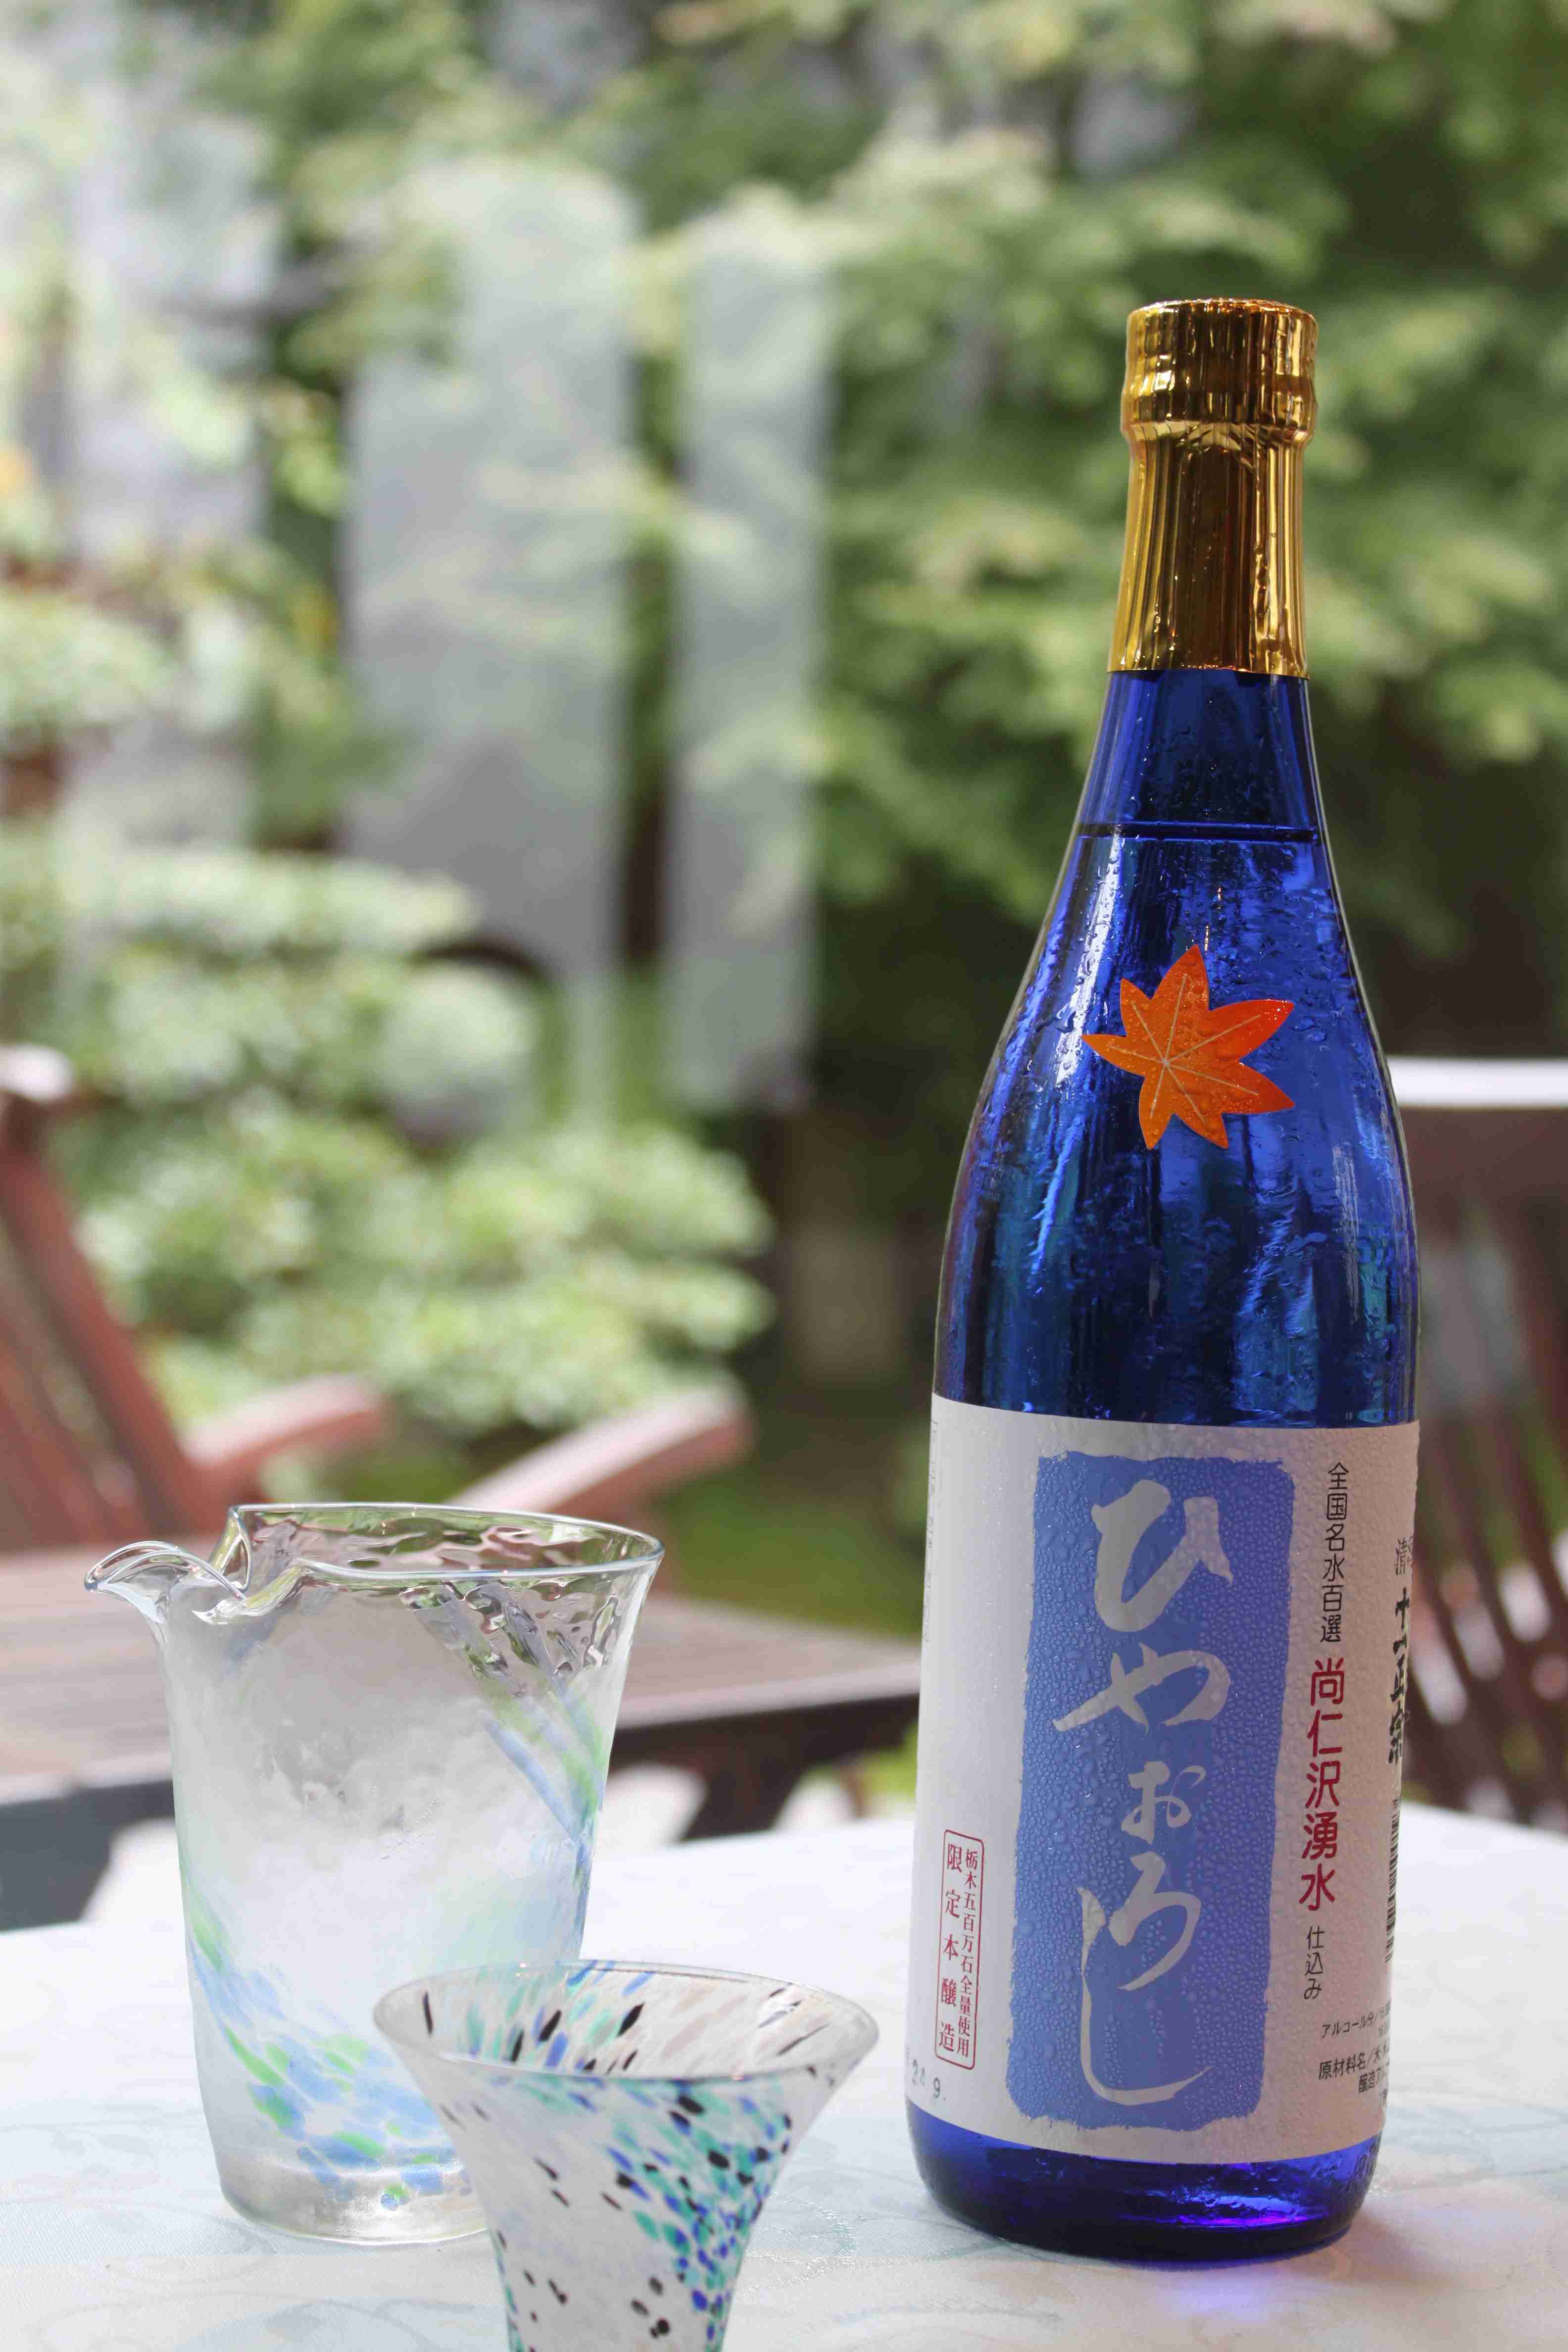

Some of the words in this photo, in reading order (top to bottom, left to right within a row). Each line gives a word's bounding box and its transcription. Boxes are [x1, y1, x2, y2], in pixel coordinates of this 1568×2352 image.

[1320, 1462, 1349, 1643] 全国名水百選
[1051, 1479, 1234, 2106] ひやおろし
[1299, 1657, 1345, 1911] 尚仁沢湧水
[939, 1843, 963, 2052] 限定本醸造
[957, 1849, 979, 2058] 栃木五百万石全量使用
[1304, 1925, 1325, 2000] 仕込み
